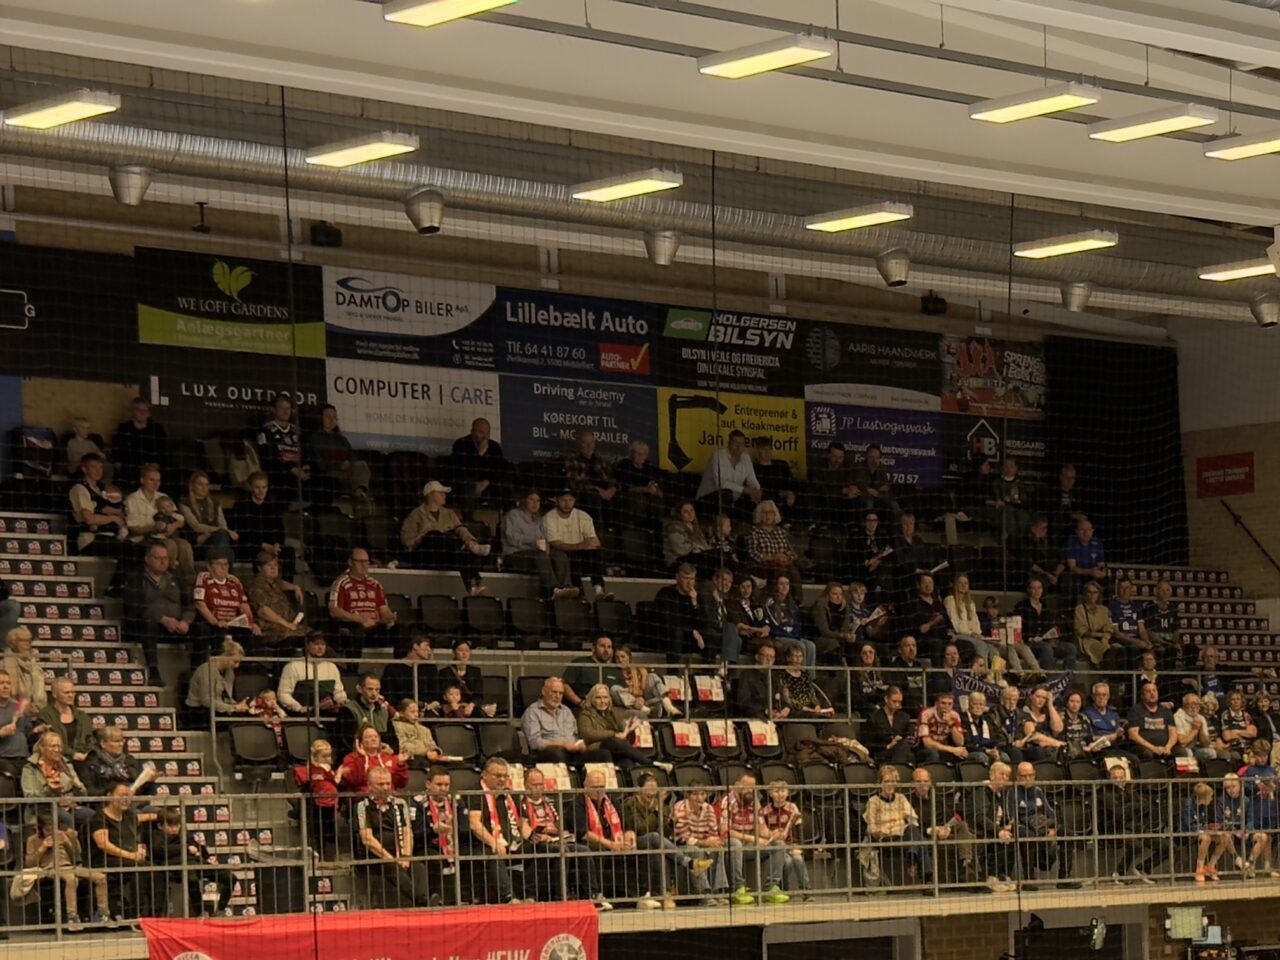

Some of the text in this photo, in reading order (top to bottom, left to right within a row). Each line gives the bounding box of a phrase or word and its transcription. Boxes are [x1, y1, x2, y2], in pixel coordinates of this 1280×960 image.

[230, 301, 290, 319] GARDENS
[335, 290, 410, 313] DAMTOP
[415, 300, 453, 317] BILER
[505, 301, 649, 336] Lillebælt Auto
[713, 313, 797, 331] HOLGERSEN
[708, 325, 794, 351] BILSYN
[525, 342, 538, 355] 64
[541, 343, 553, 356] 41
[556, 345, 570, 358] 87
[572, 346, 586, 360] 60
[181, 382, 217, 398] LUX
[334, 376, 494, 406] COMPUTER CARE
[533, 383, 626, 405] Driving Academy
[543, 412, 618, 429] KØREKORT TIL
[734, 404, 798, 420] Entreprenør &
[532, 426, 549, 439] BIL
[593, 431, 629, 444] RAILER
[741, 419, 798, 433] kloakmester
[698, 431, 724, 446] Jan
